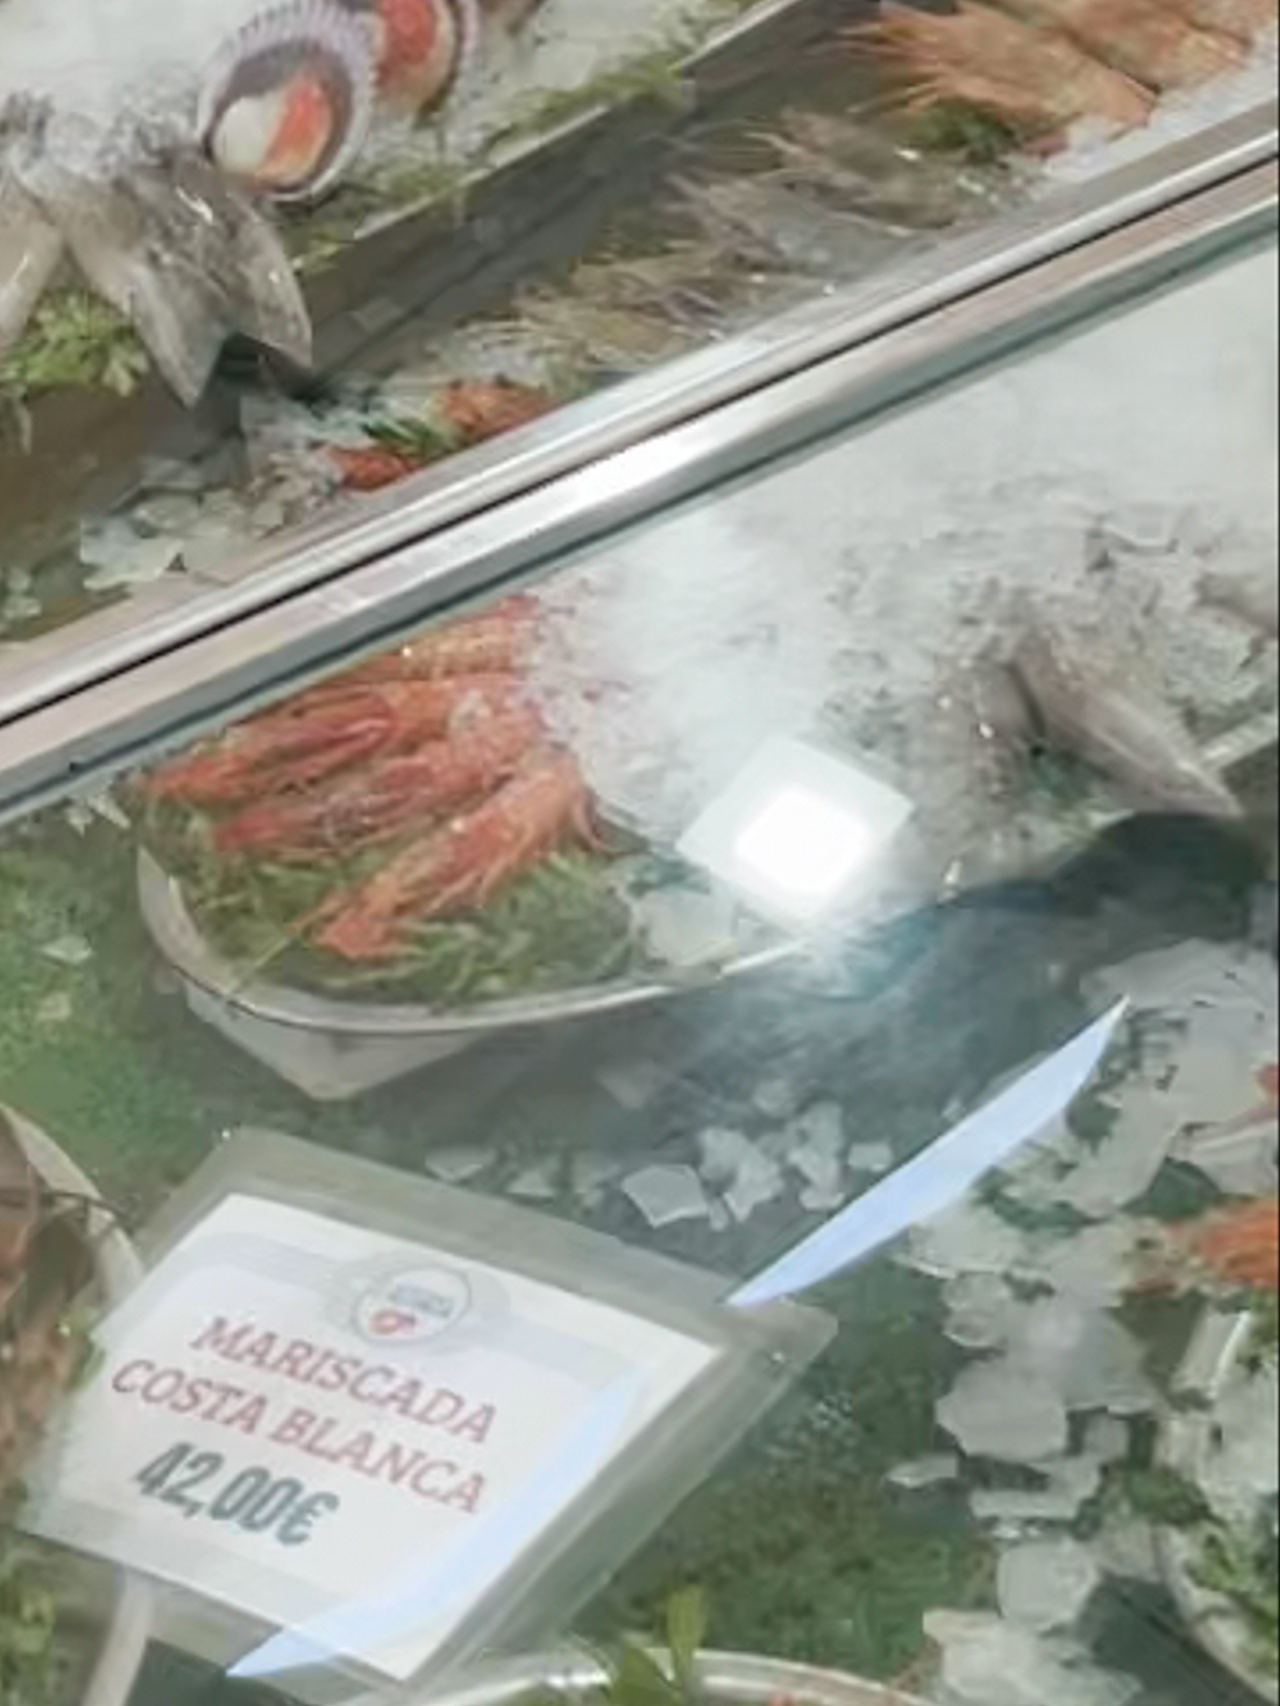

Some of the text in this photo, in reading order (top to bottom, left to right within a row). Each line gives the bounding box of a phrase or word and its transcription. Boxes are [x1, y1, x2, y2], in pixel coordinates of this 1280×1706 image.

[111, 1357, 488, 1514] COSTA BLANCA
[189, 1316, 498, 1444] MARISCADA
[134, 1441, 339, 1547] 42,00€
